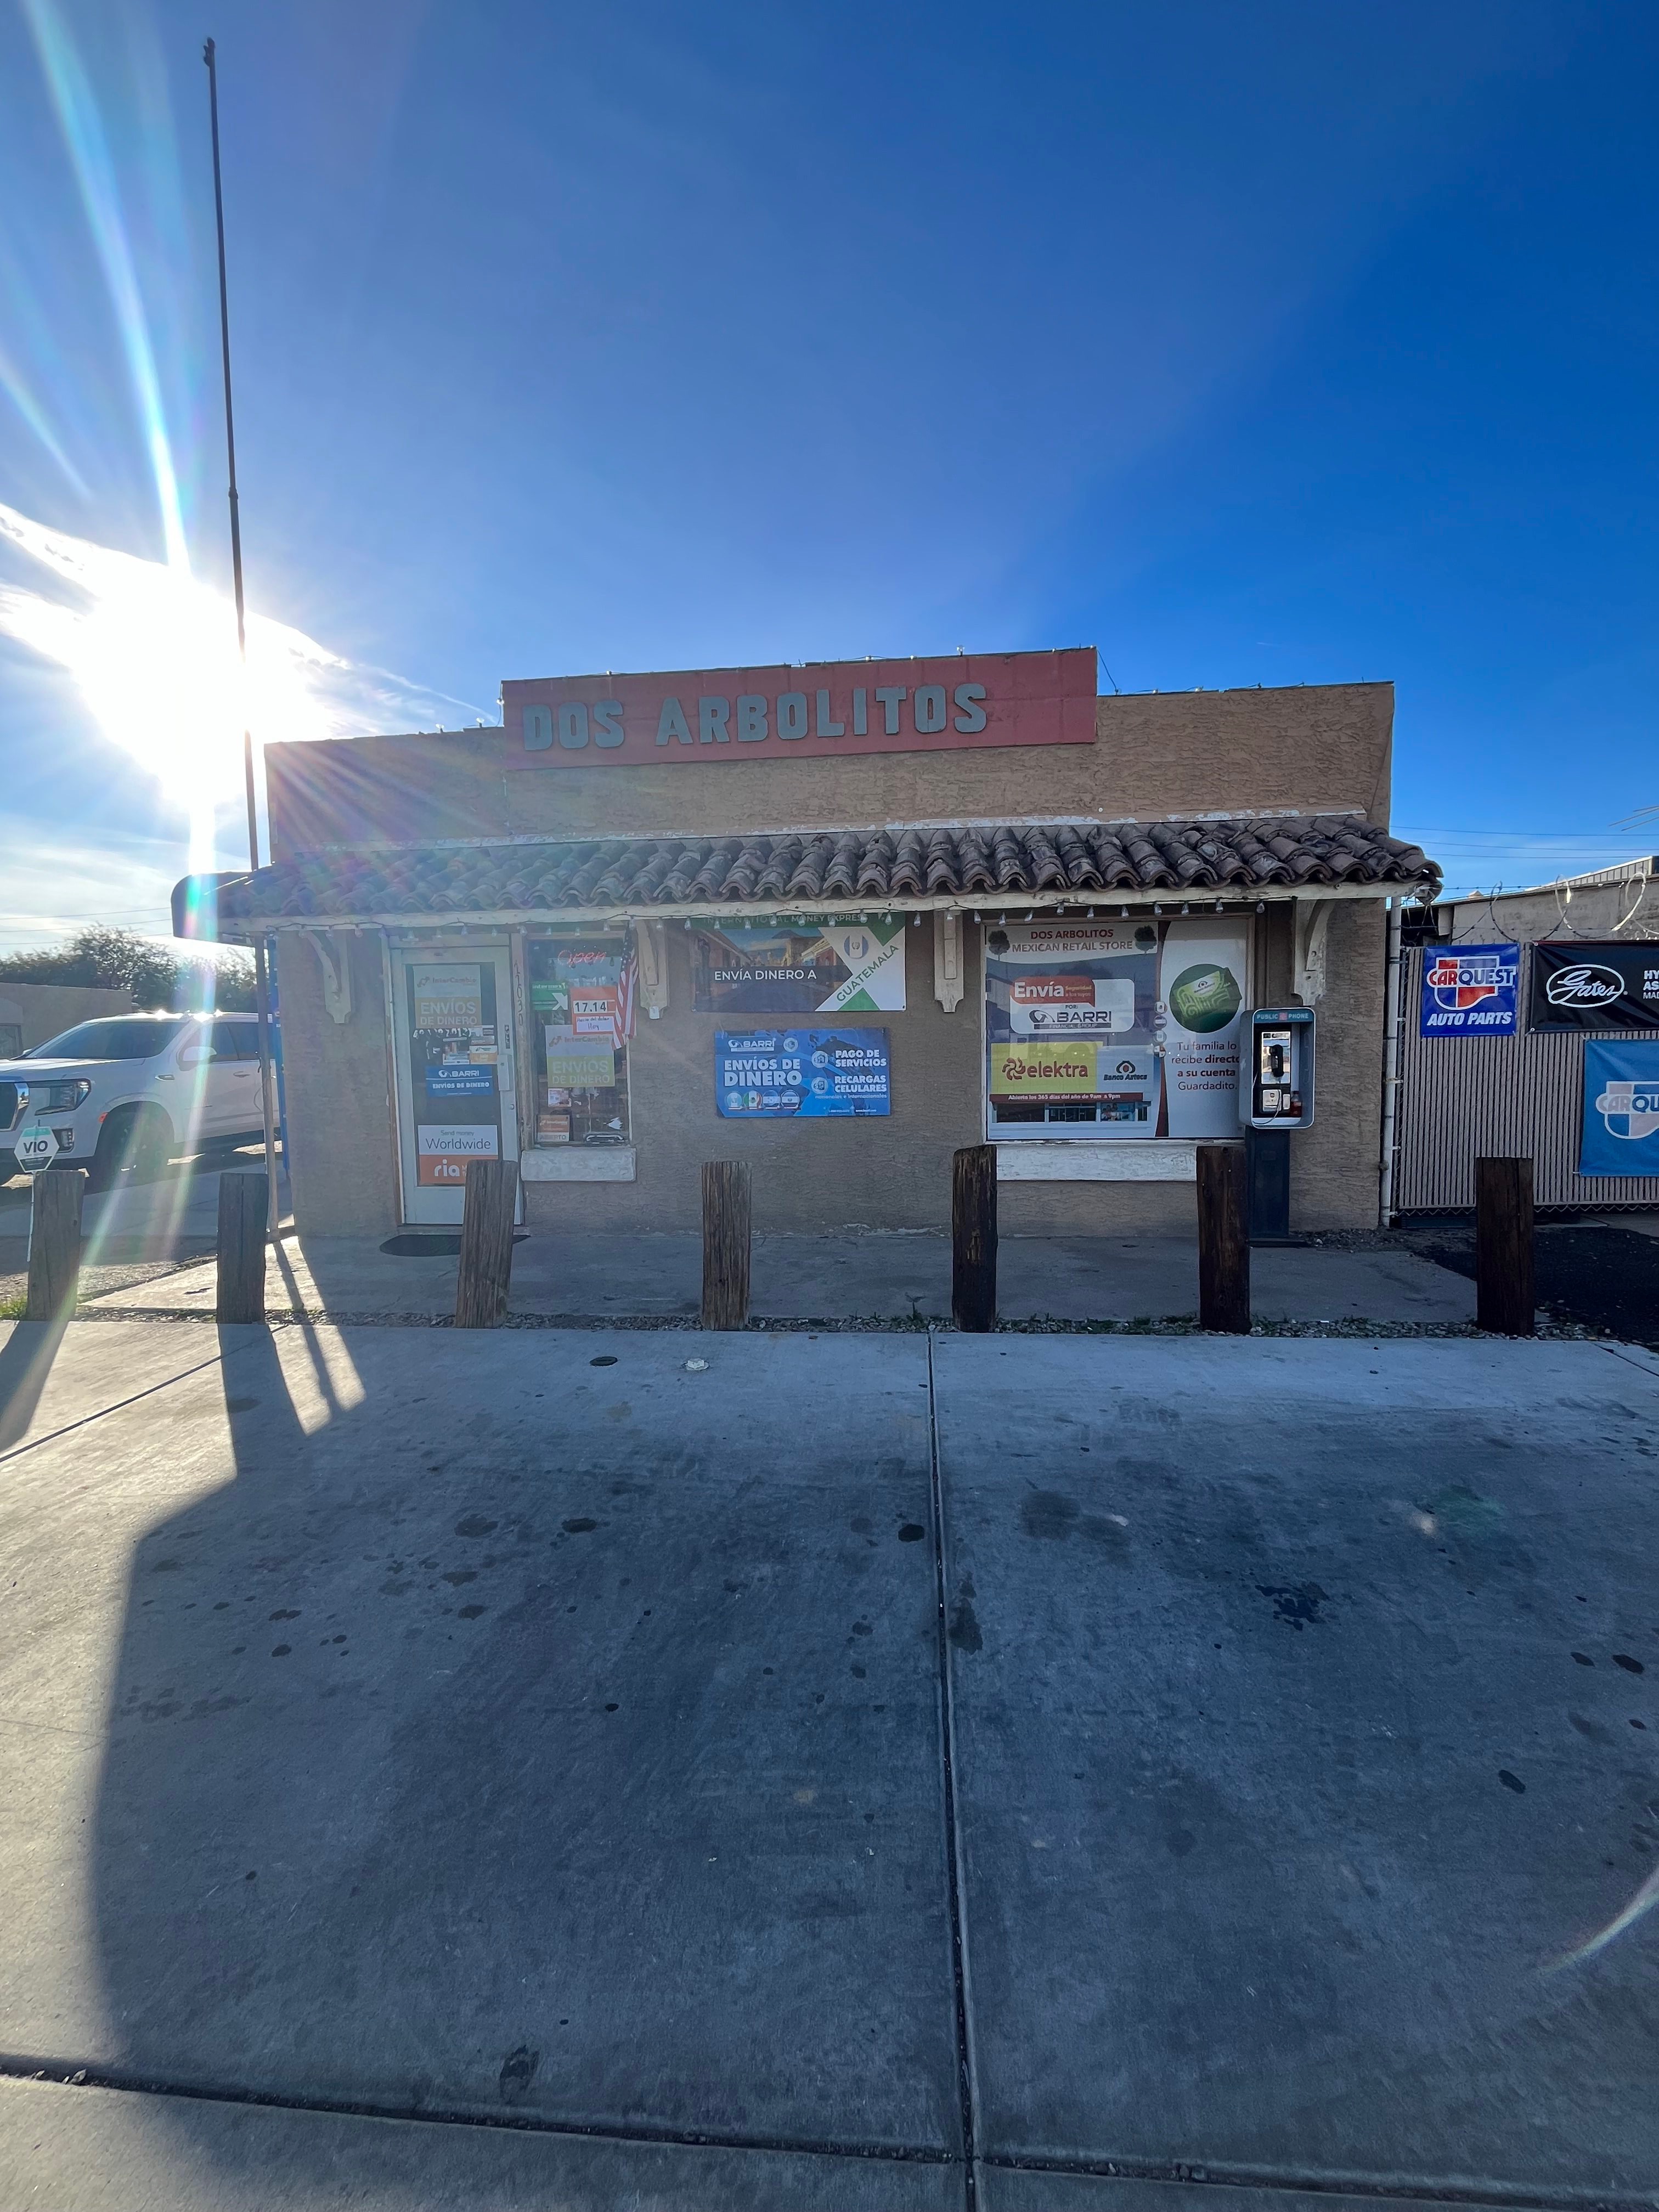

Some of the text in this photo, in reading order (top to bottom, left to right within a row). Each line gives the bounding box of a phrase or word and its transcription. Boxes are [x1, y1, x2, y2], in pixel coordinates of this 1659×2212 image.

[522, 682, 988, 751] DOS ARBOLITOS
[828, 913, 867, 922] EXPRES
[1031, 929, 1114, 939] DOS ARBOLITOS
[1012, 941, 1133, 952] MEXICAN RETAIL STORE
[715, 968, 817, 981] ENVÍA DINERO A
[837, 945, 899, 1002] GUATEMALA
[1429, 966, 1516, 986] CARQUEST
[1014, 981, 1064, 997] Envía
[1555, 969, 1619, 997] Gates
[421, 998, 476, 1014] ENVÍOS
[575, 1001, 606, 1012] 17.14
[420, 1016, 477, 1025] DE DINERO
[1057, 1011, 1111, 1023] BARRI
[1426, 1010, 1513, 1026] AUTO PARTS
[1177, 1040, 1237, 1051] Tu familia lo
[836, 1049, 879, 1058] PAGO DE
[1171, 1054, 1203, 1064] recibe
[552, 1057, 608, 1074] ENVÍOS
[724, 1056, 800, 1070] ENVÍOS DE
[835, 1058, 887, 1067] SERVICIOS
[1027, 1060, 1088, 1078] elektra
[1200, 1069, 1235, 1077] cuenta
[552, 1075, 610, 1084] DE DINERO
[724, 1070, 802, 1087] DINERO
[834, 1075, 887, 1084] RECARGAS
[834, 1084, 887, 1093] CELULARES
[23, 1140, 48, 1154] VIO
[425, 1138, 491, 1150] Worldwide
[434, 1159, 460, 1177] ria
